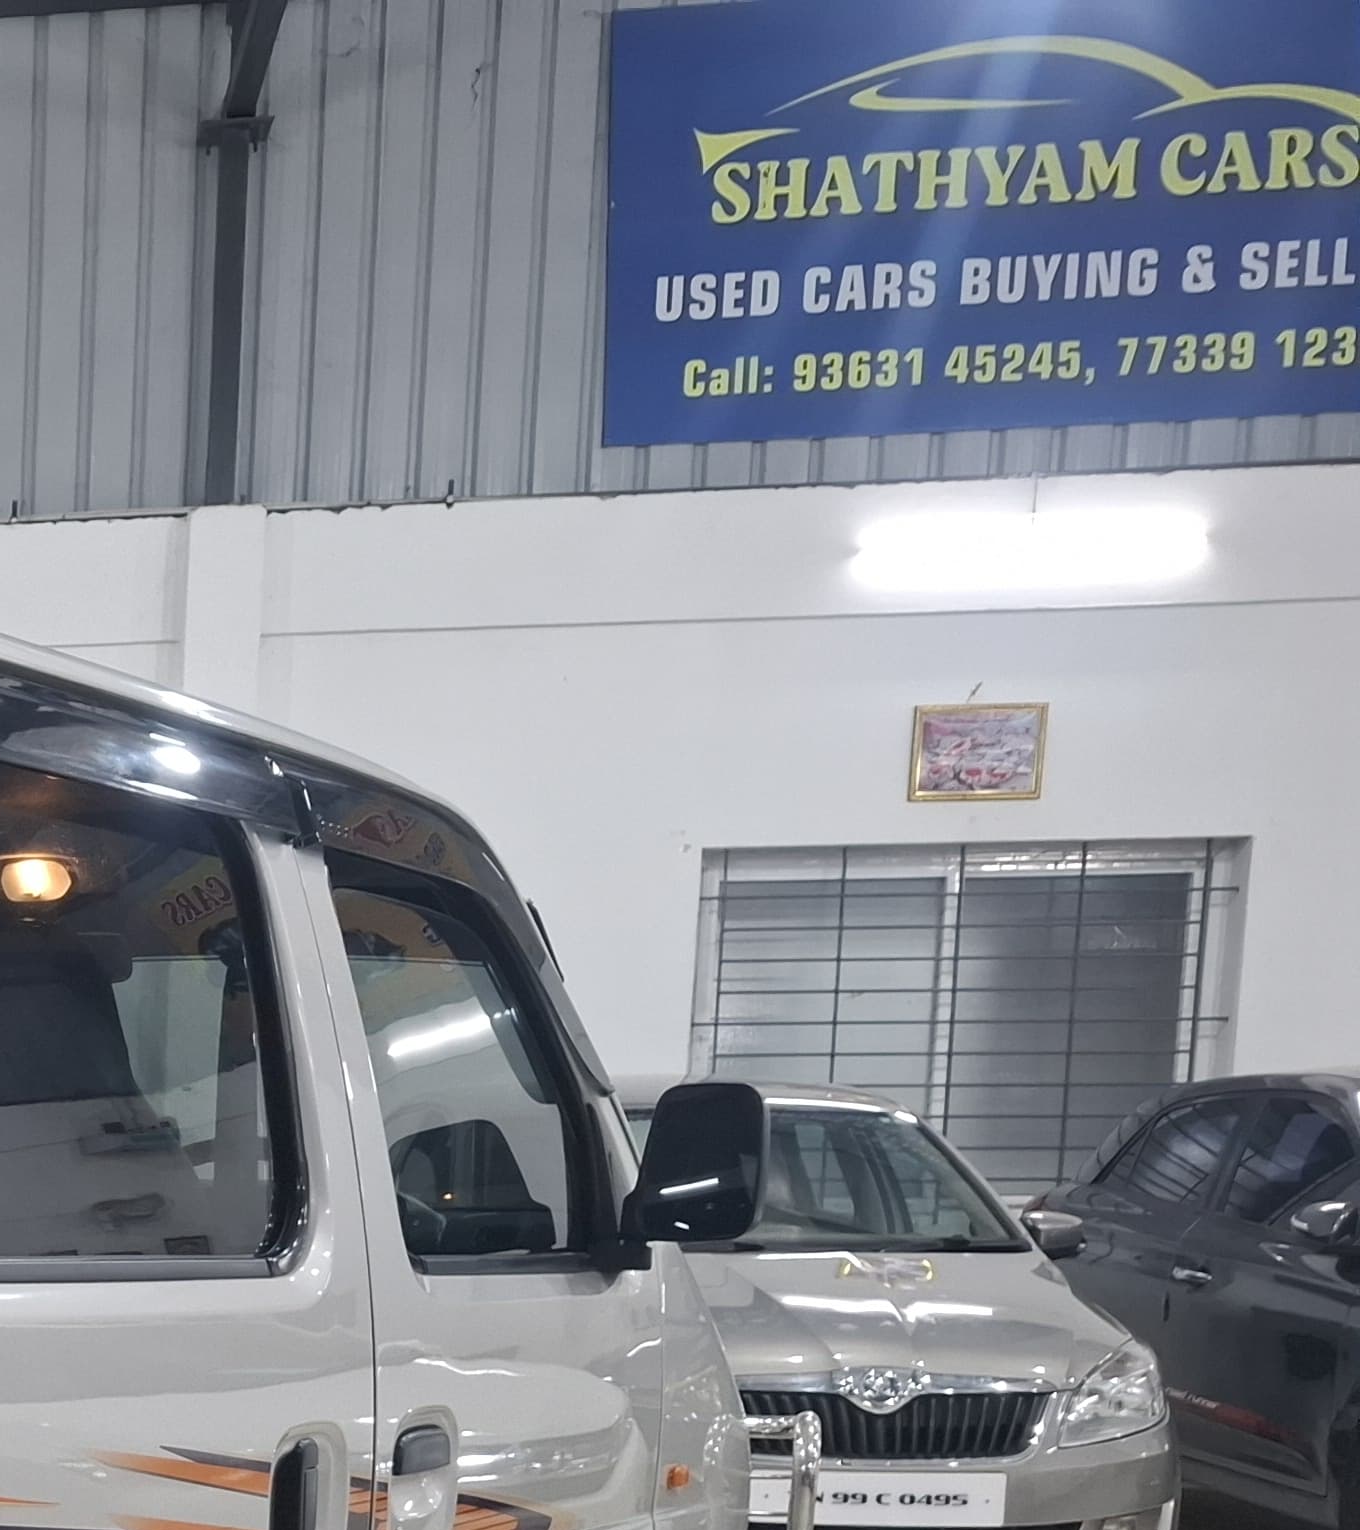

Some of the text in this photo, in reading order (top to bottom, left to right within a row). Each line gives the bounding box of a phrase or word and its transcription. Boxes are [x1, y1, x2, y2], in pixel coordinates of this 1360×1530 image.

[710, 124, 1360, 226] SHATHYAM CARS
[654, 236, 1357, 323] USED CARS BUYING & SELL
[682, 325, 1358, 399] Call: 93631 45245, 77339 123
[831, 1491, 868, 1505] 99
[876, 1492, 891, 1506] C
[898, 1493, 969, 1506] 0495
